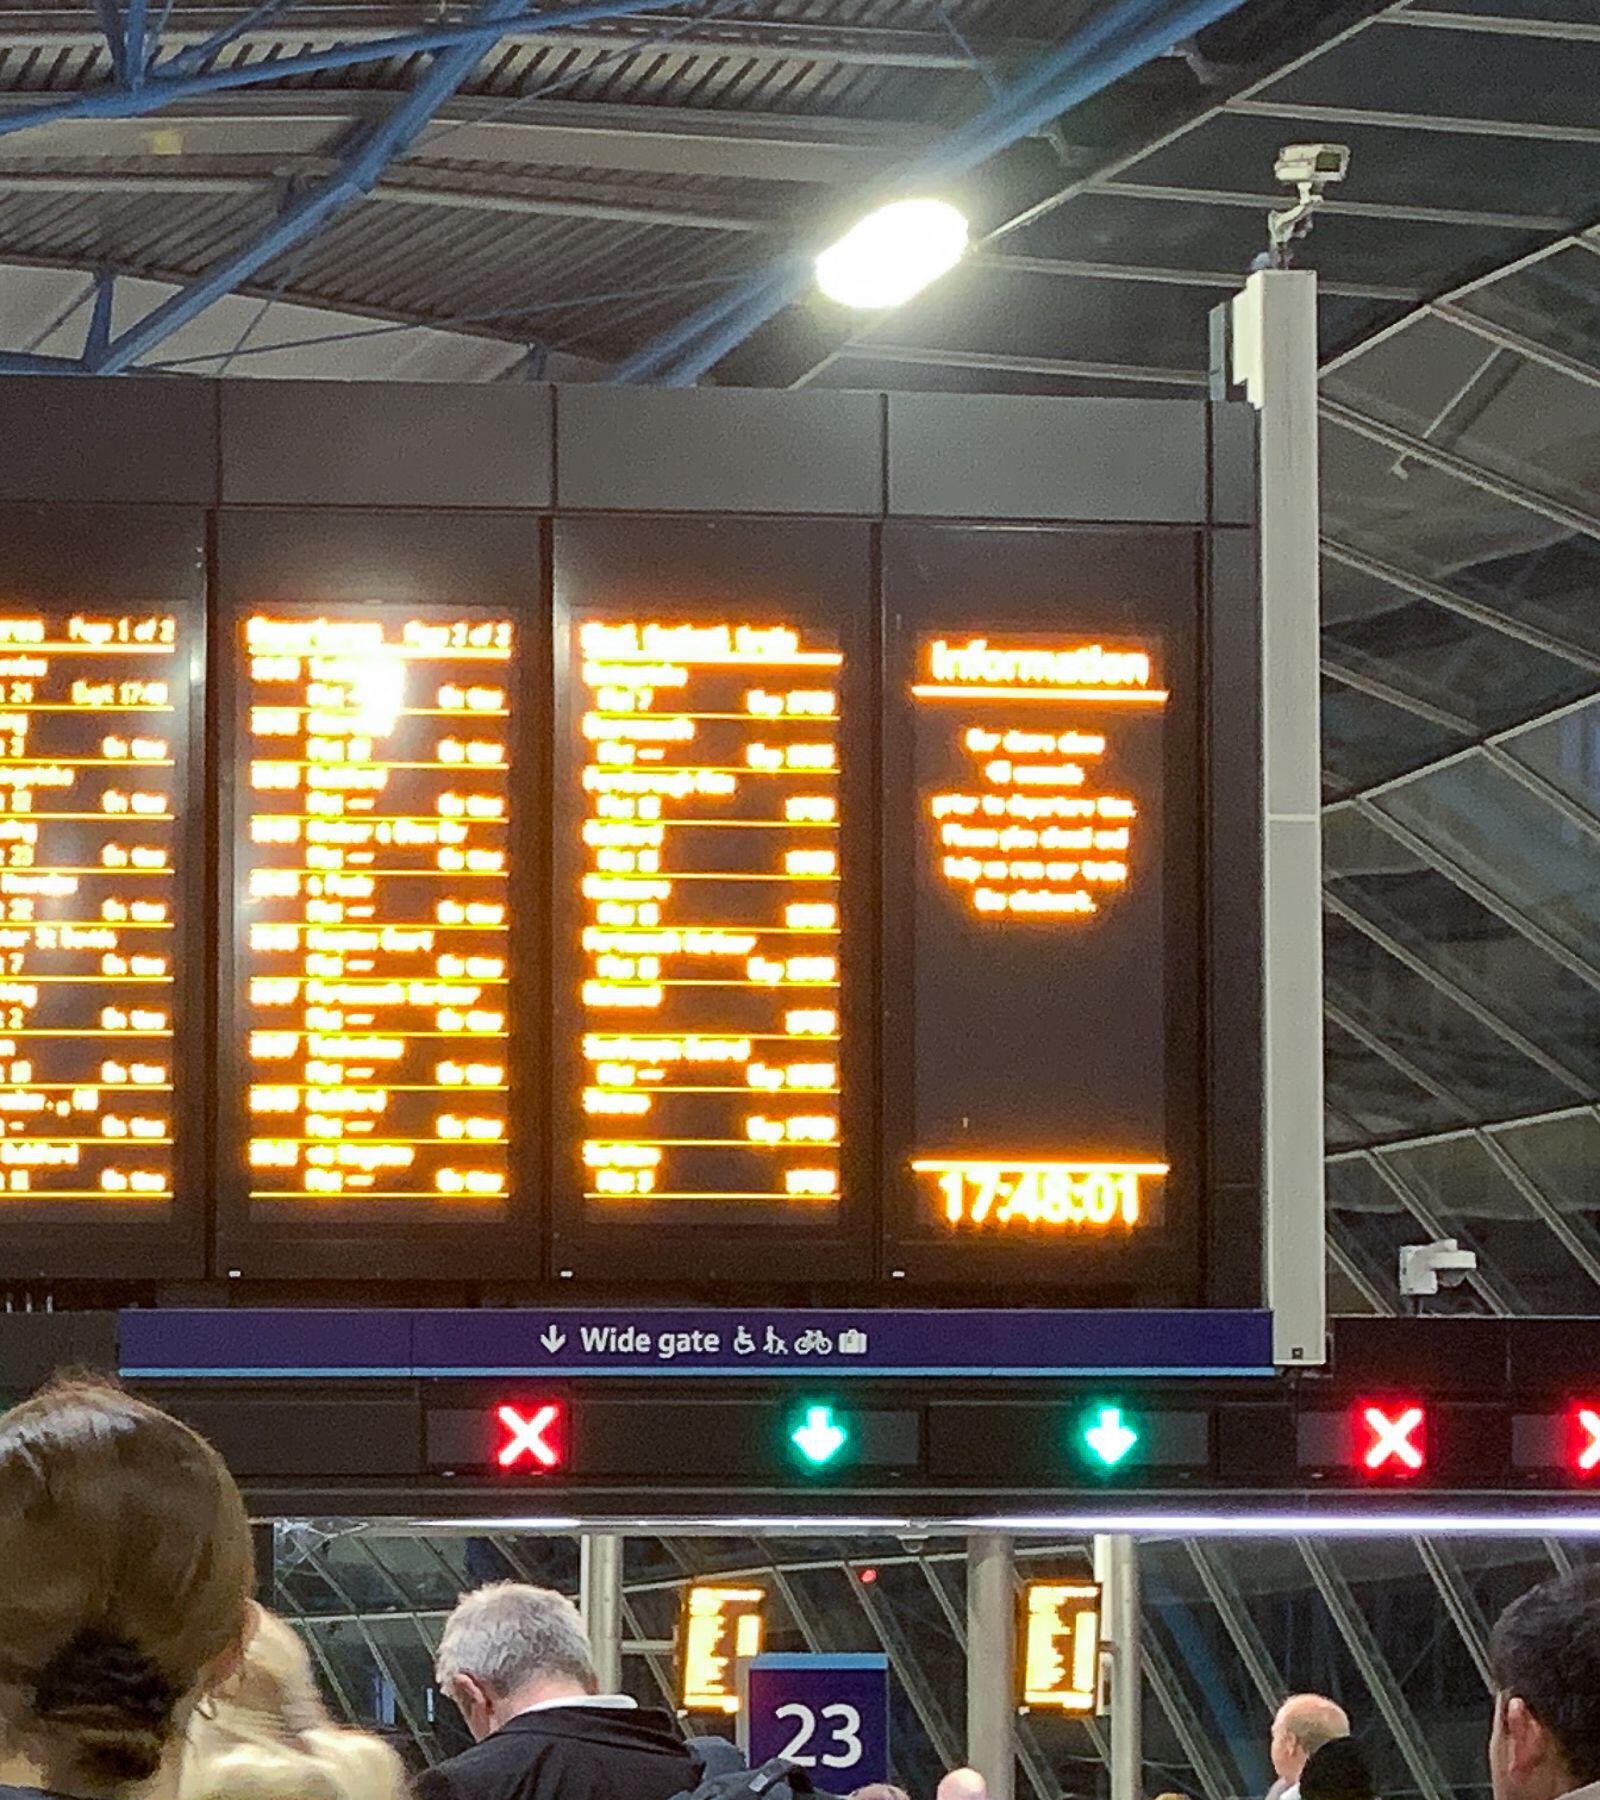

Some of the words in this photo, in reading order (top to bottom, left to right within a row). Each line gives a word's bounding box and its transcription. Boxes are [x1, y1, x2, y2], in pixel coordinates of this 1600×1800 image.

[933, 640, 1149, 683] Information
[580, 1326, 651, 1353] Wide
[659, 1330, 720, 1359] gate
[774, 1703, 862, 1768] 23
